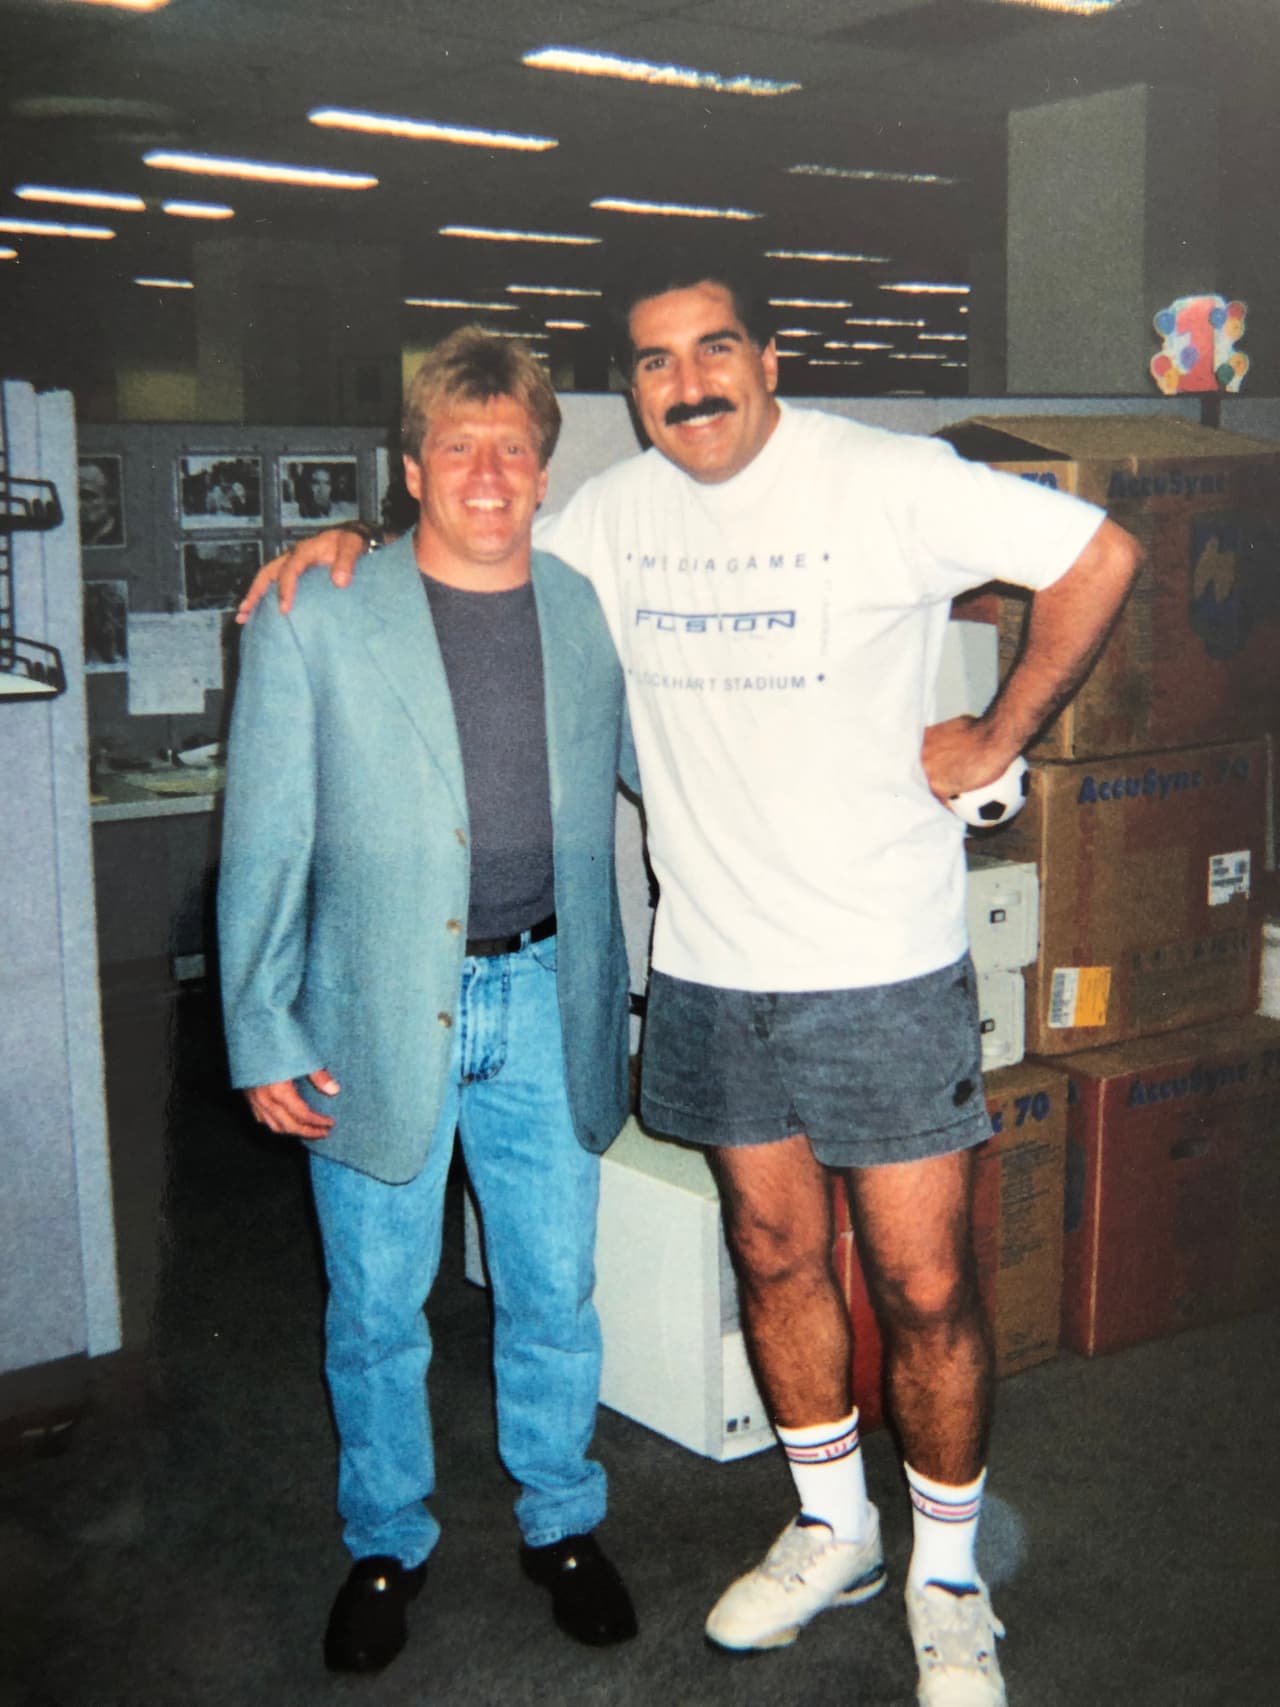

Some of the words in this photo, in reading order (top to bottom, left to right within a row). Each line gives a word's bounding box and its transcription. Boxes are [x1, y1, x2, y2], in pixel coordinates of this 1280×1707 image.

[635, 609, 796, 633] FUSION
[724, 676, 806, 692] STADIUM
[1077, 767, 1202, 804] AccuSync
[1014, 1091, 1050, 1127] 70
